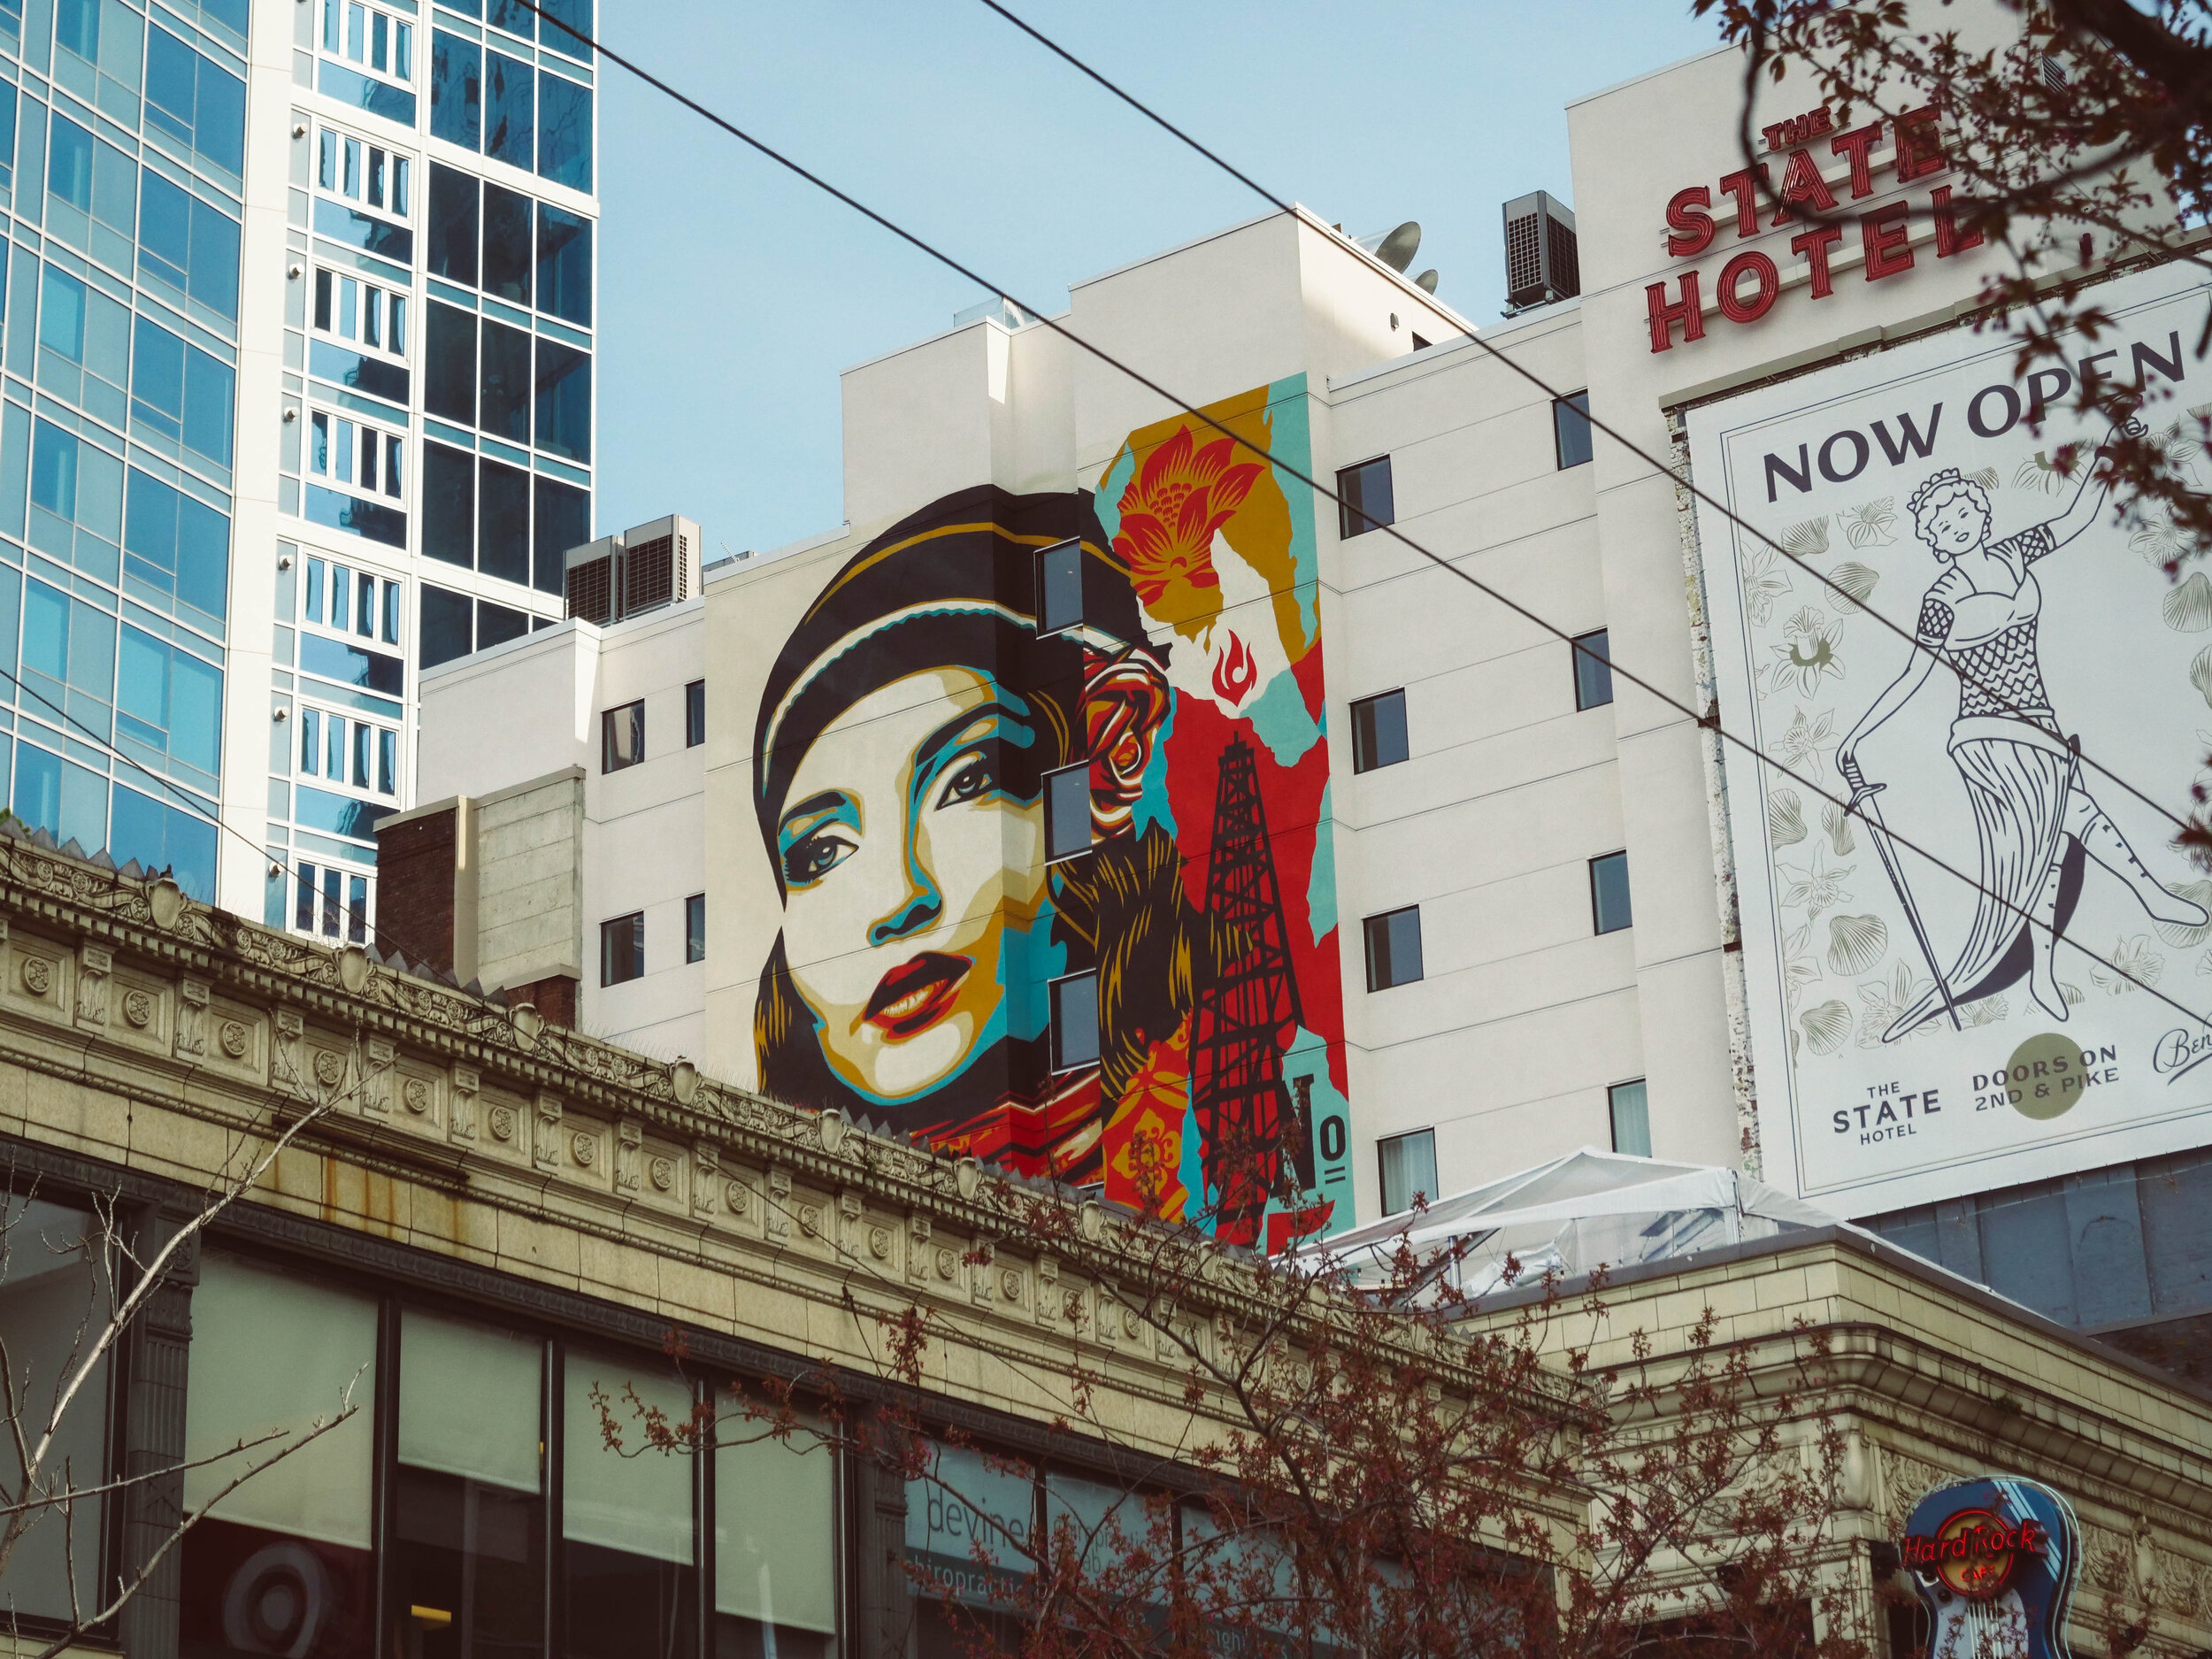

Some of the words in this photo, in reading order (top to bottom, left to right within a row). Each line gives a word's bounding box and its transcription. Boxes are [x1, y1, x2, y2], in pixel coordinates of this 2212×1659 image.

[1762, 105, 1833, 151] THE
[1665, 104, 1947, 257] STATE
[1645, 184, 1985, 354] HOTEL
[1764, 402, 1943, 503] NOW
[1968, 331, 2185, 439] OPEN
[1867, 1081, 1901, 1099] THE
[1972, 1056, 2069, 1092] DOORS
[2079, 1044, 2117, 1065] ON
[1975, 1087, 2024, 1111] 2ND
[2034, 1083, 2051, 1099] &
[2062, 1067, 2120, 1092] PIKE
[1832, 1089, 1941, 1133] STATE
[1860, 1123, 1917, 1145] HOTEL
[928, 1486, 1025, 1548] devine
[1904, 1529, 1967, 1566] Hard
[1972, 1520, 2036, 1554] Rock
[906, 1554, 1024, 1601] chiropracti
